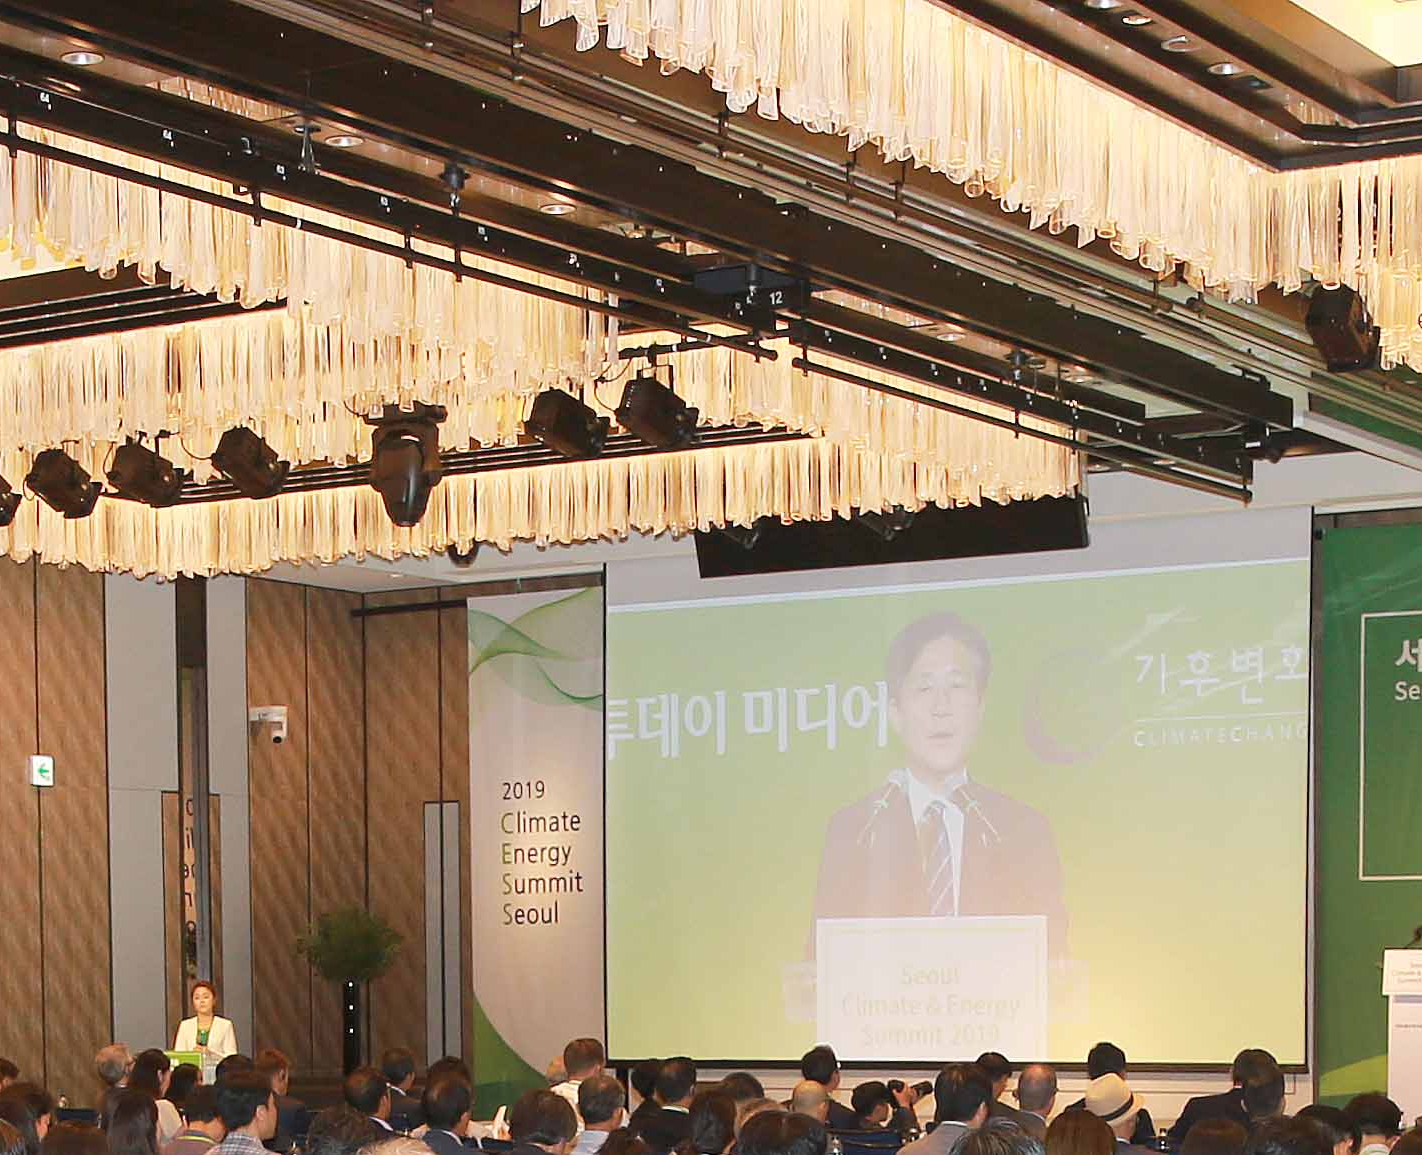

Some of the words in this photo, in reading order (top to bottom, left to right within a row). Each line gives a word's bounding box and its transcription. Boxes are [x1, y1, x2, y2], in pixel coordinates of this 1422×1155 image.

[769, 290, 783, 305] 12
[742, 680, 889, 753] 미디어
[502, 780, 545, 800] 2019
[501, 810, 582, 835] Climate
[501, 842, 572, 867] Energy
[502, 869, 584, 896] Summit
[502, 900, 559, 926] Seoul
